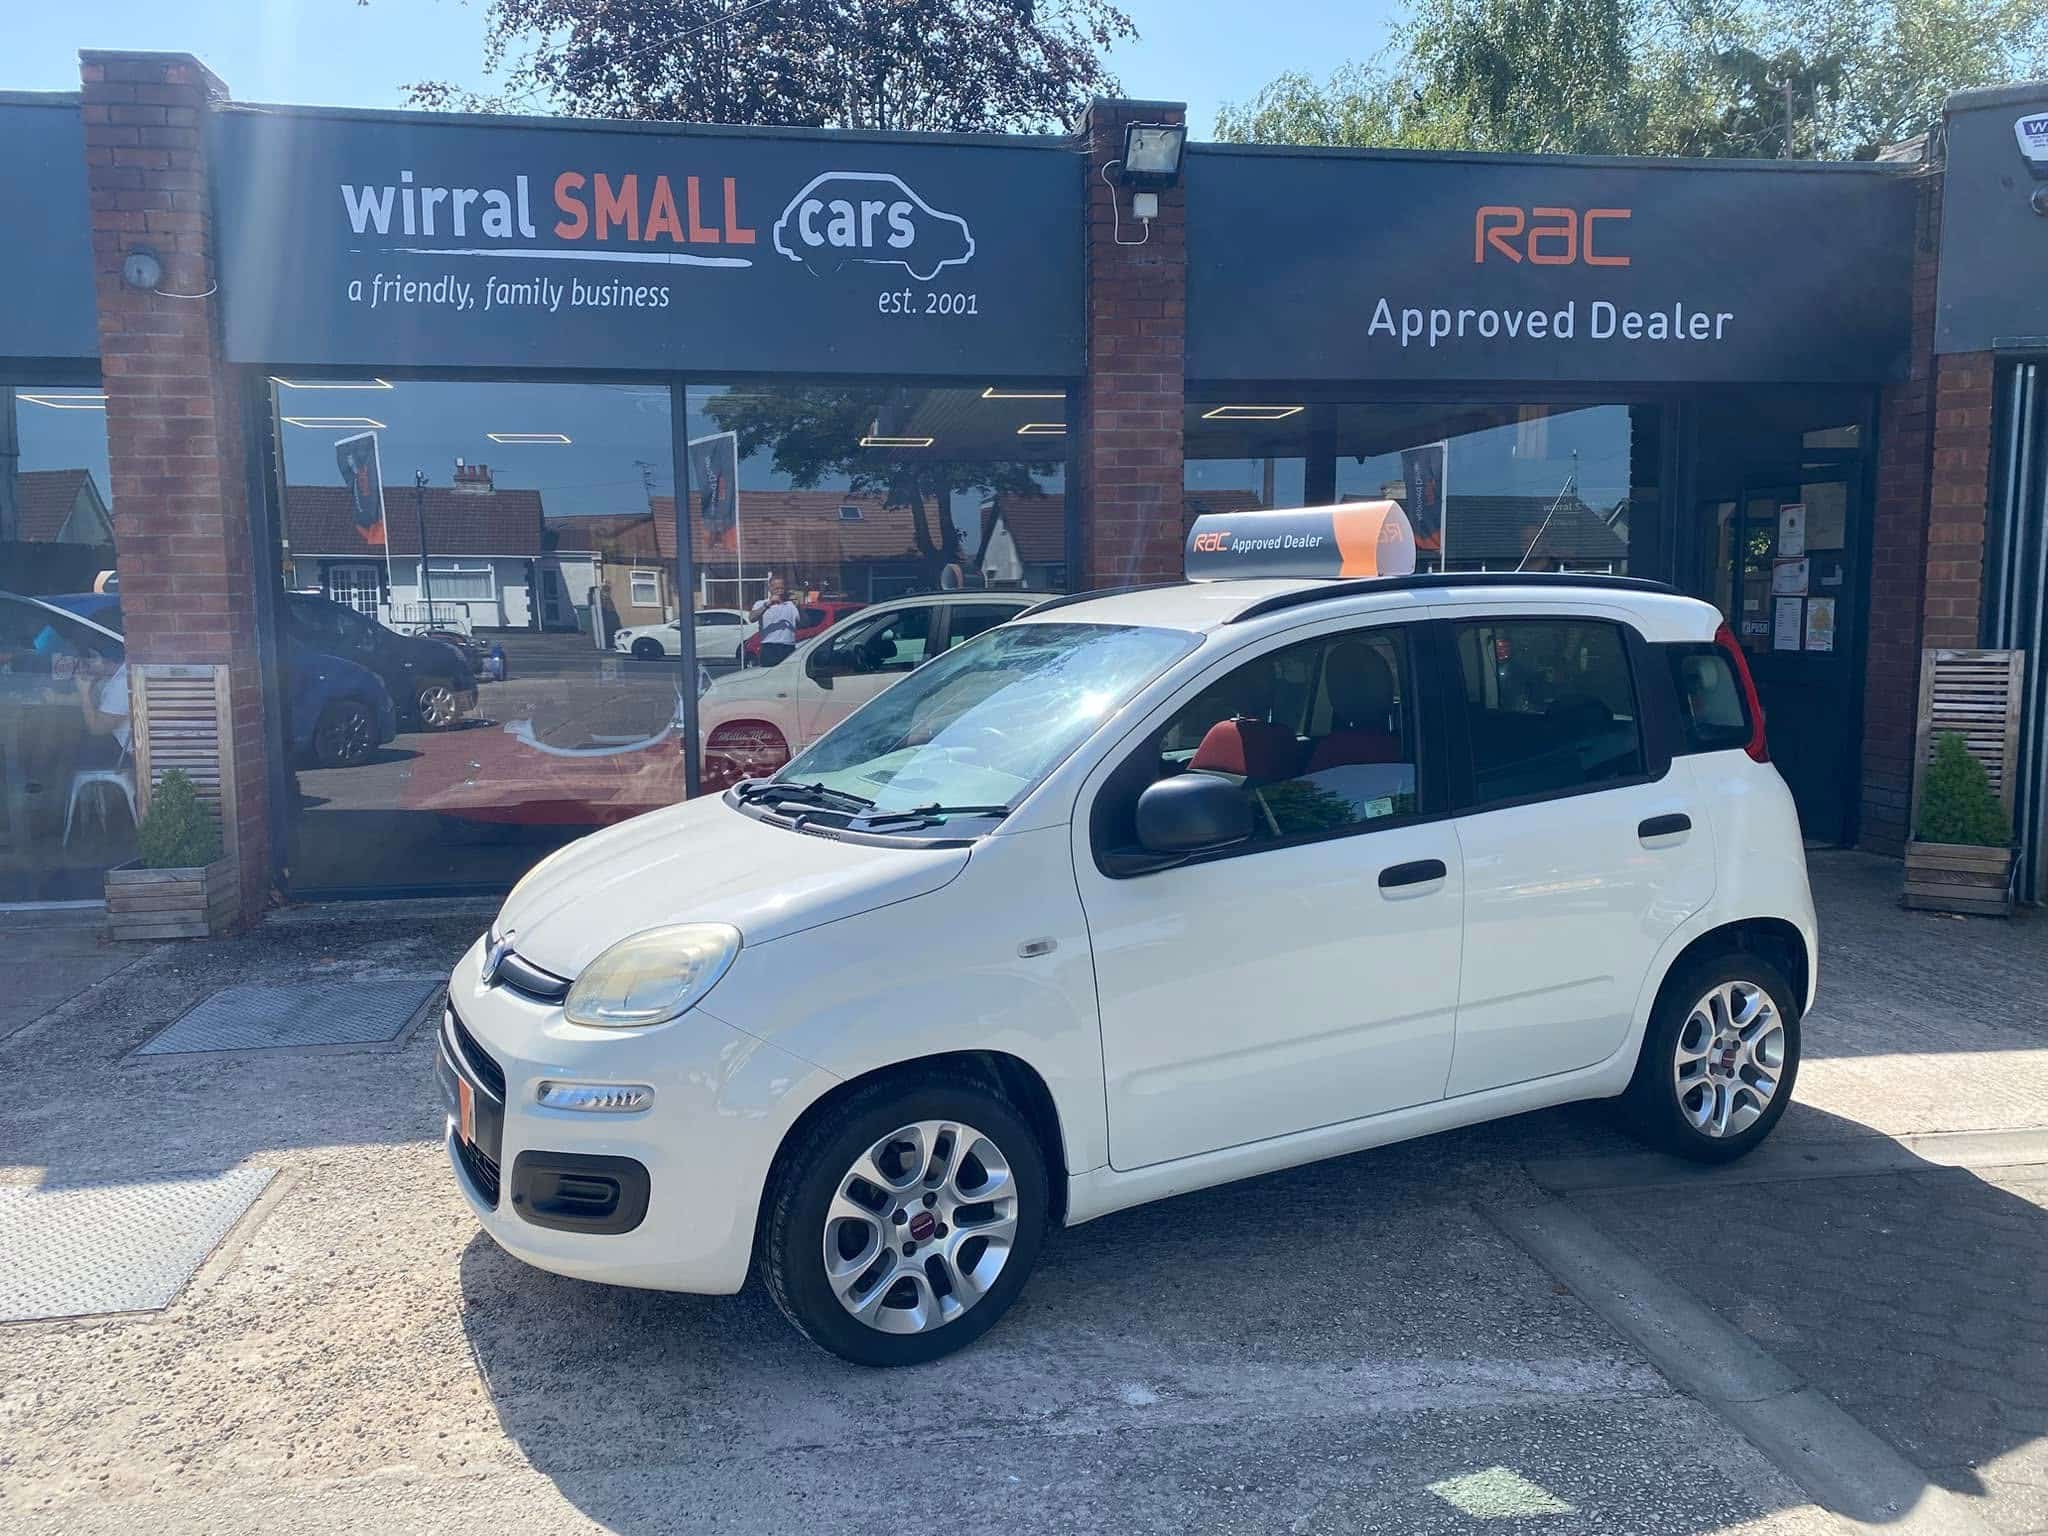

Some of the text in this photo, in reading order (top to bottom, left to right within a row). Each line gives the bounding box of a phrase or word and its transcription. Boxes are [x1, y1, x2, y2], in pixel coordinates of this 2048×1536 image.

[340, 170, 916, 249] wirral SMALL cars
[348, 273, 670, 312] a friendly, family business
[878, 287, 979, 315] est. 2001
[1367, 298, 1734, 348] Approved Dealer
[1231, 536, 1282, 554] Approved
[1283, 534, 1323, 549] Dealer
